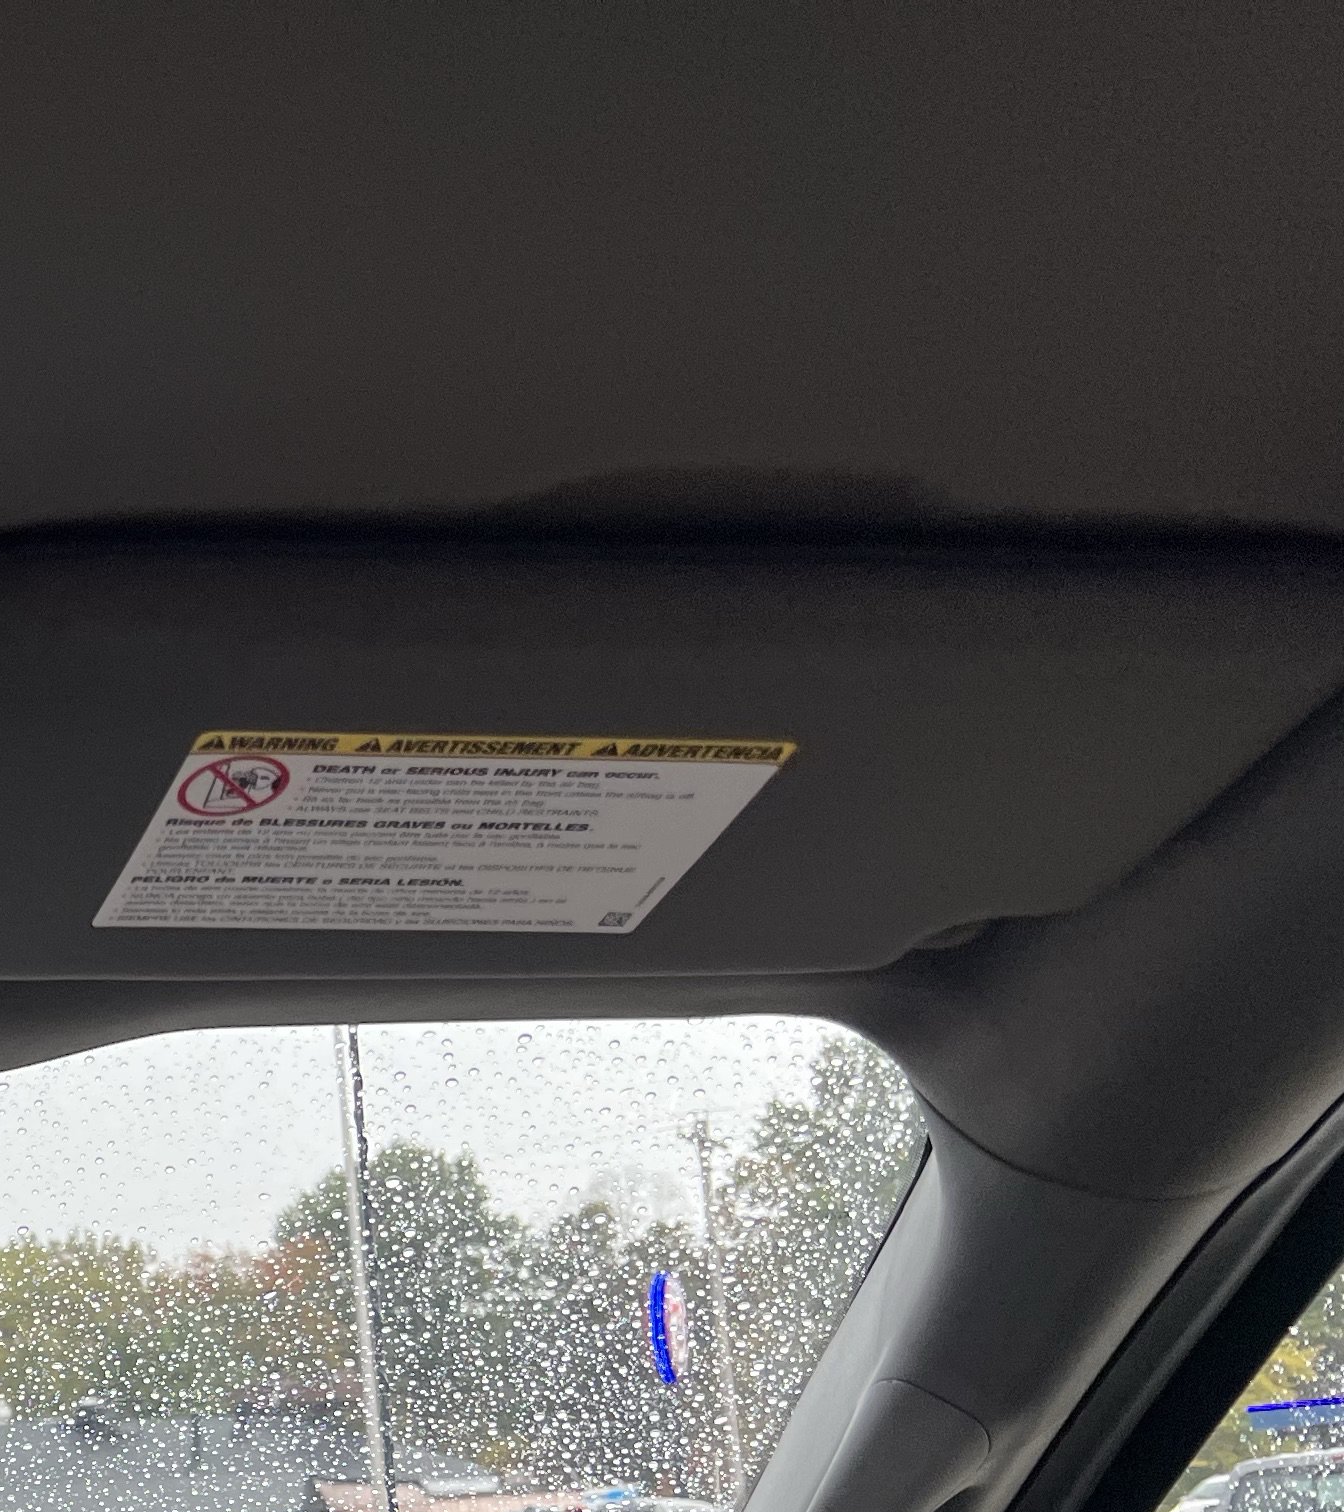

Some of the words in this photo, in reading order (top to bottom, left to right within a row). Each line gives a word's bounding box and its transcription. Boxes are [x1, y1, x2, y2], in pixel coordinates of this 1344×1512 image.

[227, 736, 339, 751] WARNING
[385, 739, 582, 756] AVERTISSEMENT
[624, 743, 785, 760] ADVERTENCIA
[313, 764, 376, 775] DEATH
[406, 766, 489, 777] SERIOUS
[494, 767, 564, 778] INJURY
[259, 818, 368, 829] BLESSURES
[372, 821, 446, 830] GRAVES
[241, 876, 318, 886] MUERTE
[337, 877, 390, 886] SERIA
